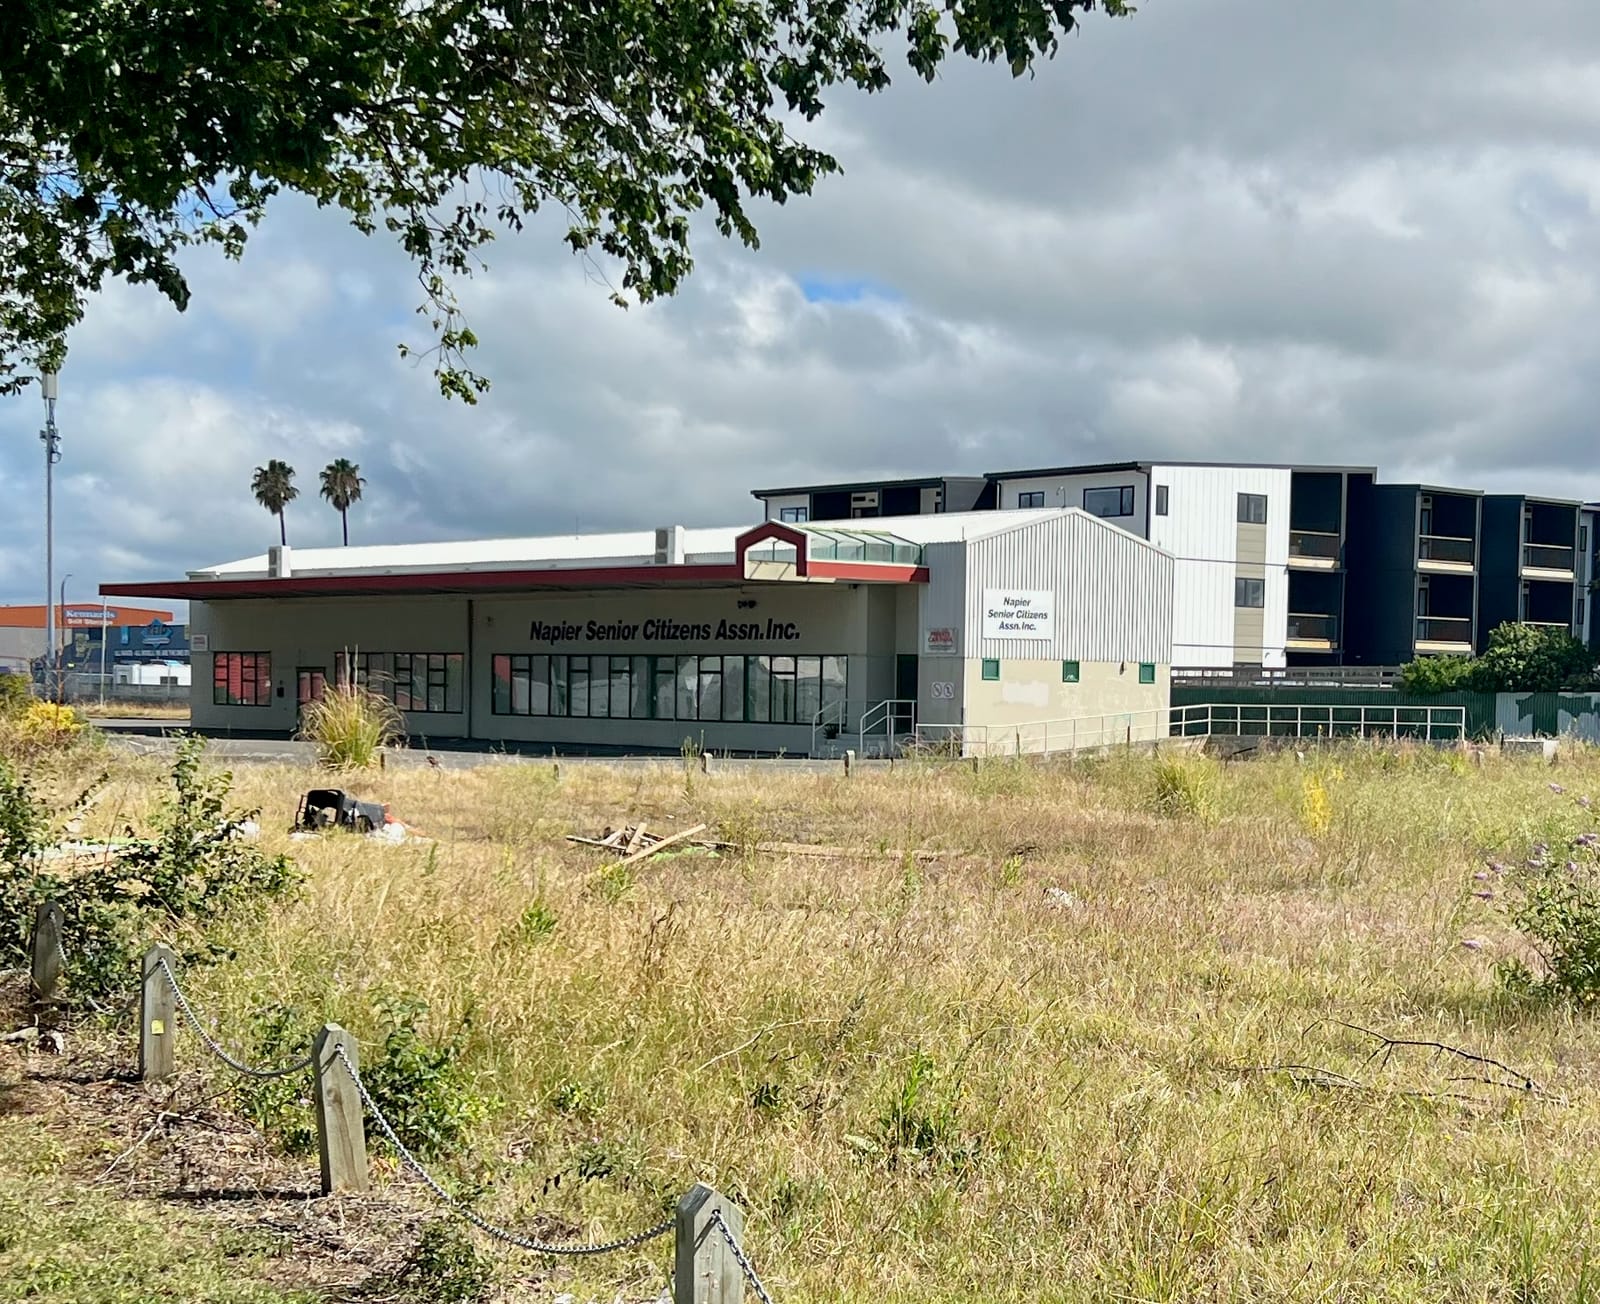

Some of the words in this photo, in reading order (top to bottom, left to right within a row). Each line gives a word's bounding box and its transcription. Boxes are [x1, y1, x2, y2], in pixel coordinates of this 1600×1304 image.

[1003, 597, 1031, 608] Napier
[988, 609, 1014, 619] Senior
[1016, 609, 1048, 620] Citizens
[530, 621, 582, 645] Napier
[585, 620, 638, 641] Senior
[643, 618, 711, 641] Citizens
